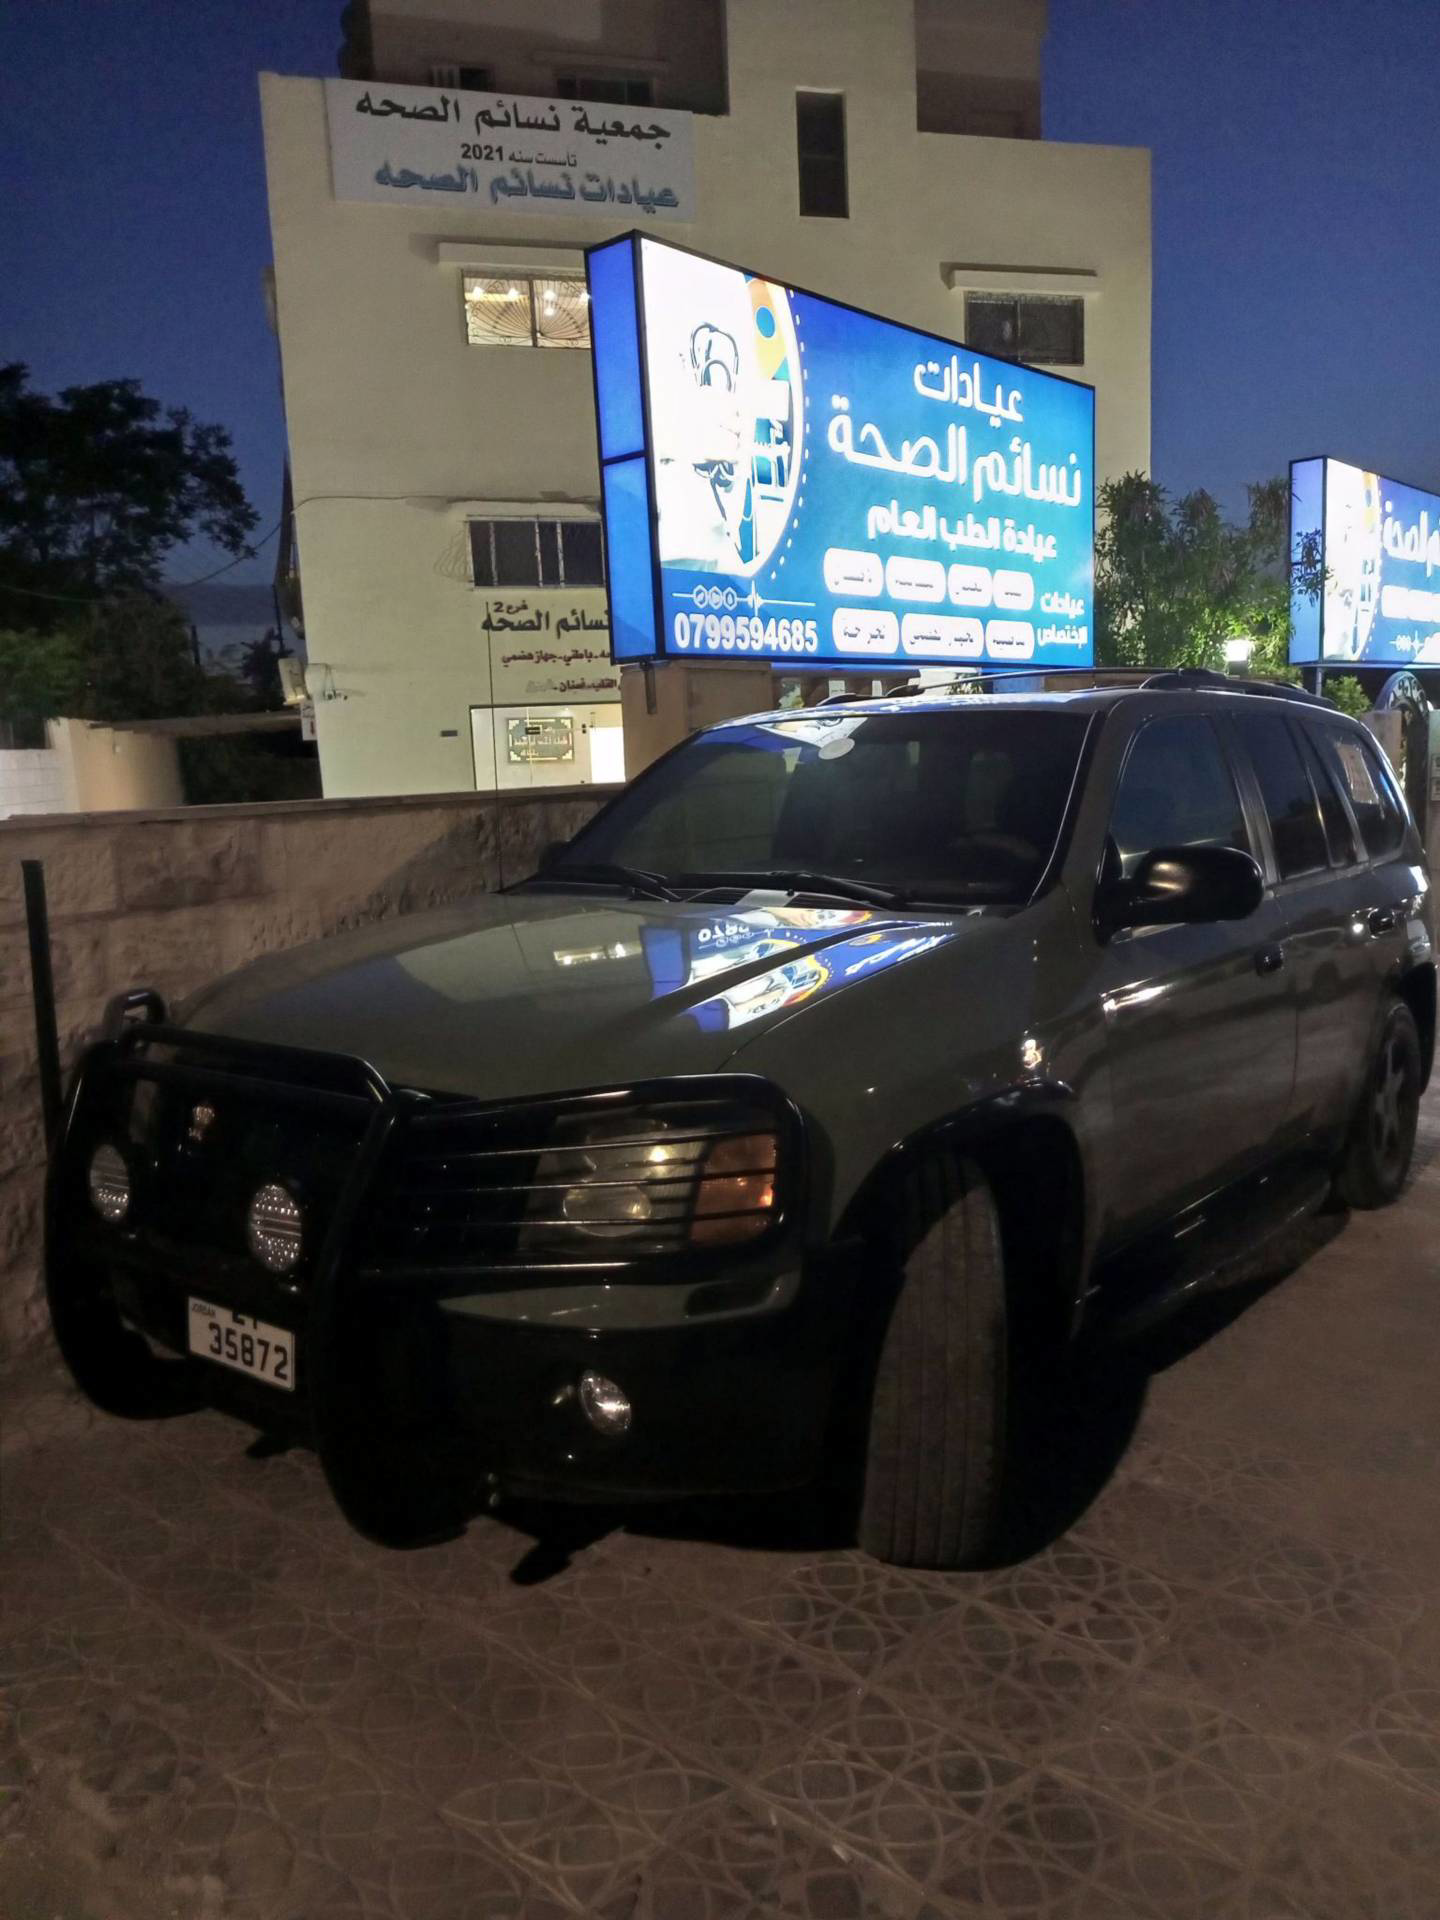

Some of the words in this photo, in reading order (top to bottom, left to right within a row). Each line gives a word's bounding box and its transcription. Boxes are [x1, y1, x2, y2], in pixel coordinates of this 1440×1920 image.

[355, 91, 461, 123] الصحه
[475, 99, 561, 136] نسائم
[571, 106, 671, 150] جمعية
[460, 143, 504, 162] 2021
[374, 160, 480, 193] الصحه
[489, 166, 577, 203] نسائم
[578, 173, 679, 215] عيادات
[913, 355, 1024, 428] عيادات
[828, 394, 967, 485] الصحة
[973, 436, 1081, 508] نسائم
[867, 499, 937, 540] العام
[940, 513, 1001, 551] الطب
[1003, 517, 1057, 563] عيادة
[481, 609, 550, 632] الصحه
[493, 601, 504, 613] 2
[506, 600, 529, 615] فرع
[1040, 591, 1085, 620] عيادات
[674, 612, 818, 652] 0799594685
[208, 1321, 288, 1381] 35872
